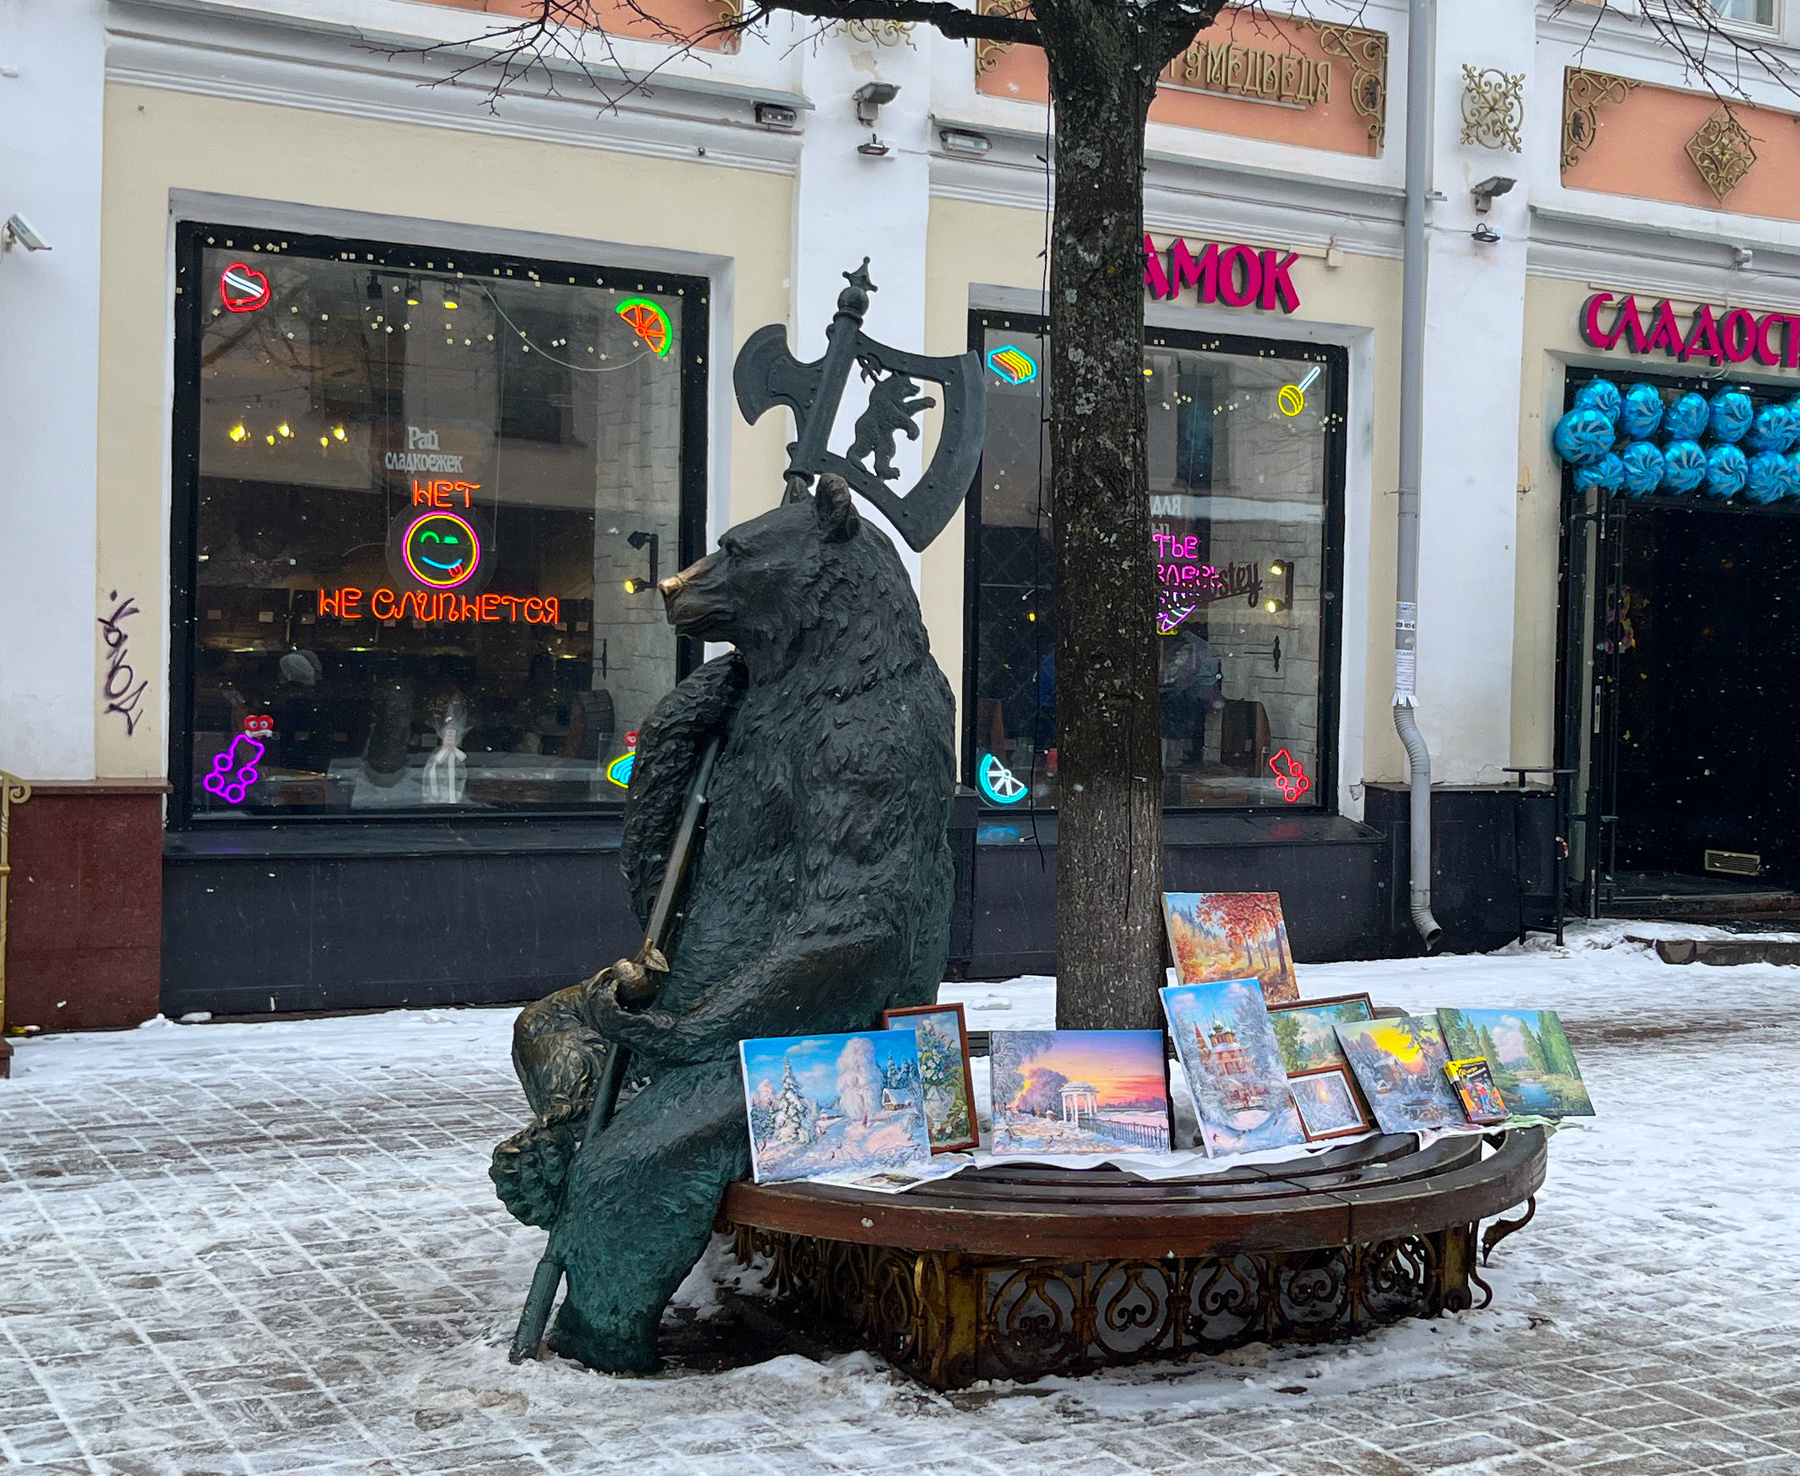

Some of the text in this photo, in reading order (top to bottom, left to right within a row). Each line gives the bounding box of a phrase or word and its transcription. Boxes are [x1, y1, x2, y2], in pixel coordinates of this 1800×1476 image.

[407, 426, 440, 451] Рай
[413, 479, 482, 508] НЕТ
[319, 587, 560, 625] НЕ СЛИПНЕТСЯ
